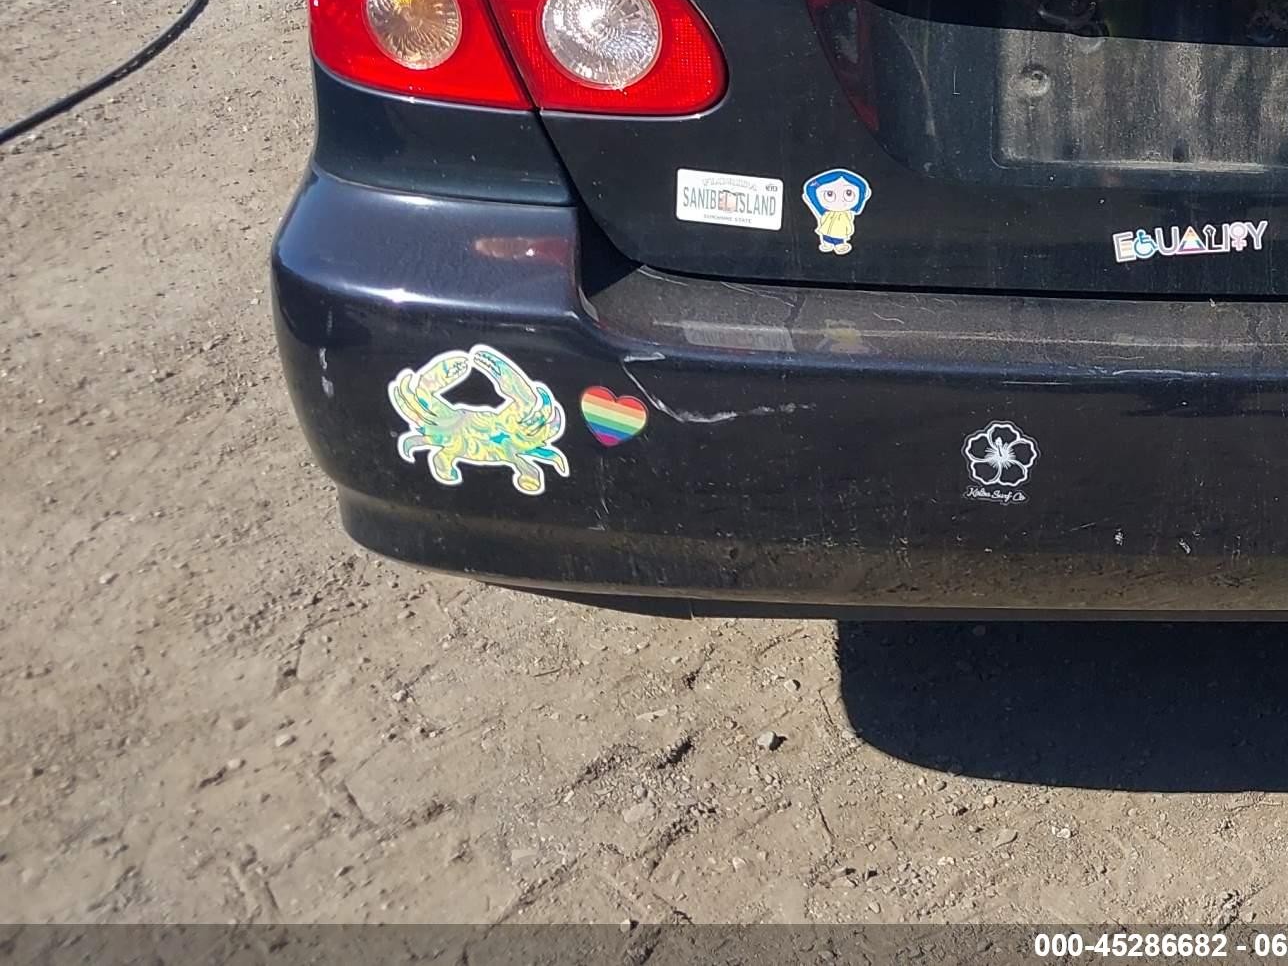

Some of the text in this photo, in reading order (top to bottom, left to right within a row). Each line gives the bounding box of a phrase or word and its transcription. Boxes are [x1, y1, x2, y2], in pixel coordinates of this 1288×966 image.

[683, 187, 776, 216] SANIBEL ISLAND
[991, 490, 1012, 502] Surf
